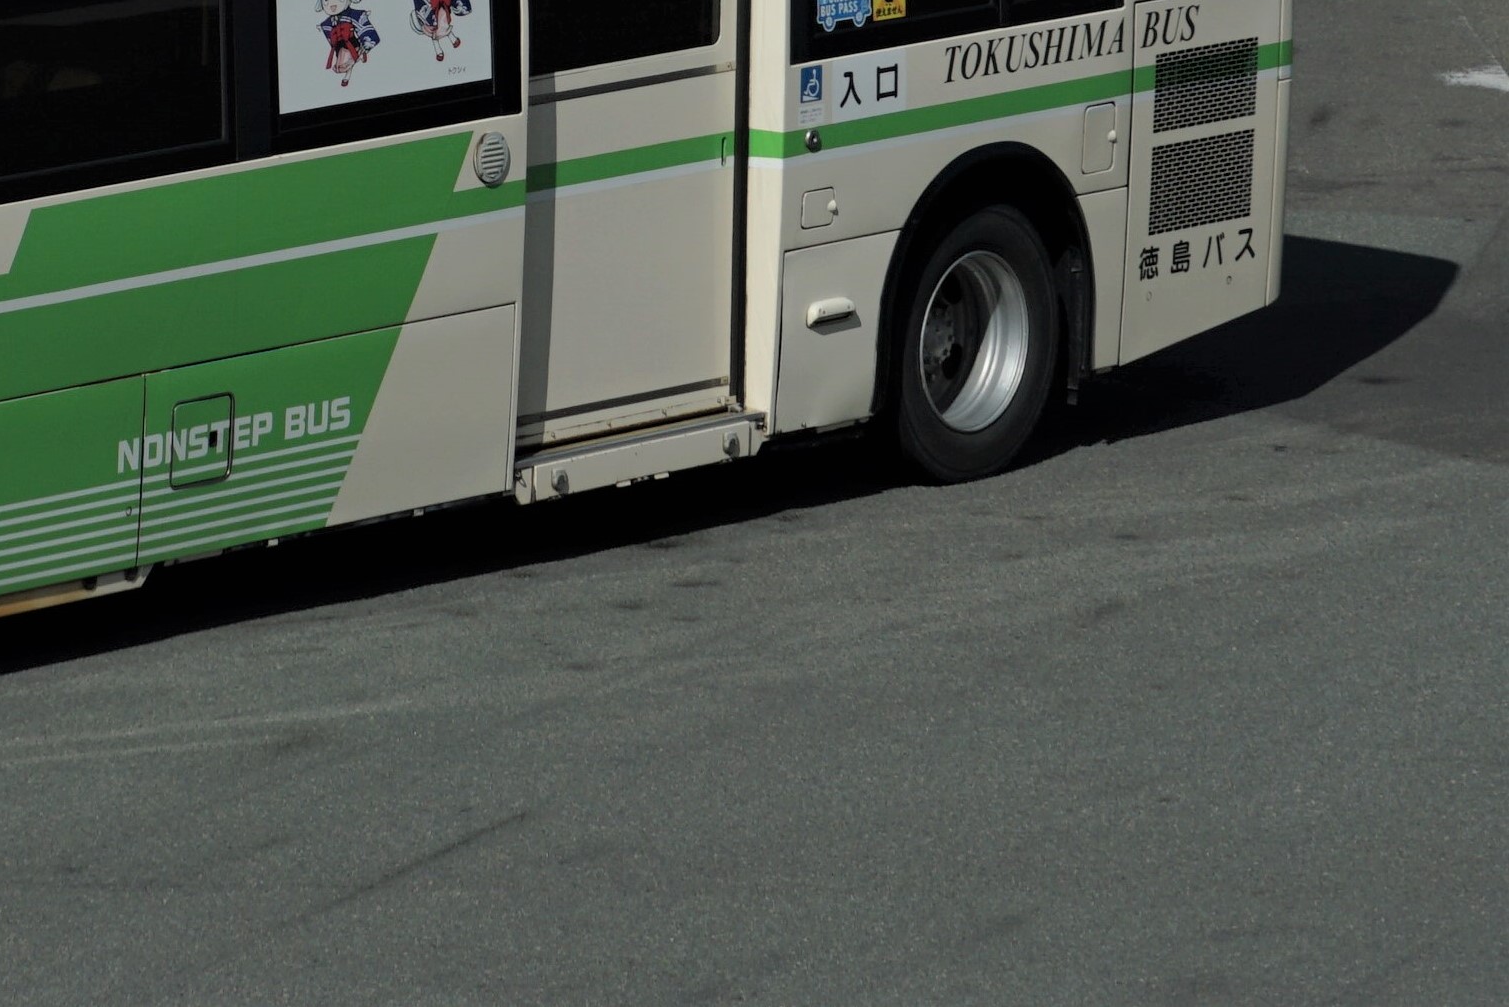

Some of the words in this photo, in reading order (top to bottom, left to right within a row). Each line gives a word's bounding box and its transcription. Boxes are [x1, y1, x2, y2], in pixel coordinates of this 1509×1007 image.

[820, 4, 837, 17] BUS
[838, 0, 859, 13] PASS
[944, 17, 1126, 84] TOKUSHIMA
[1140, 5, 1200, 49] BUS
[840, 63, 898, 108] 入口
[1139, 228, 1255, 281] 徳島バス
[117, 411, 273, 474] NONSTEP
[284, 396, 351, 440] BUS
